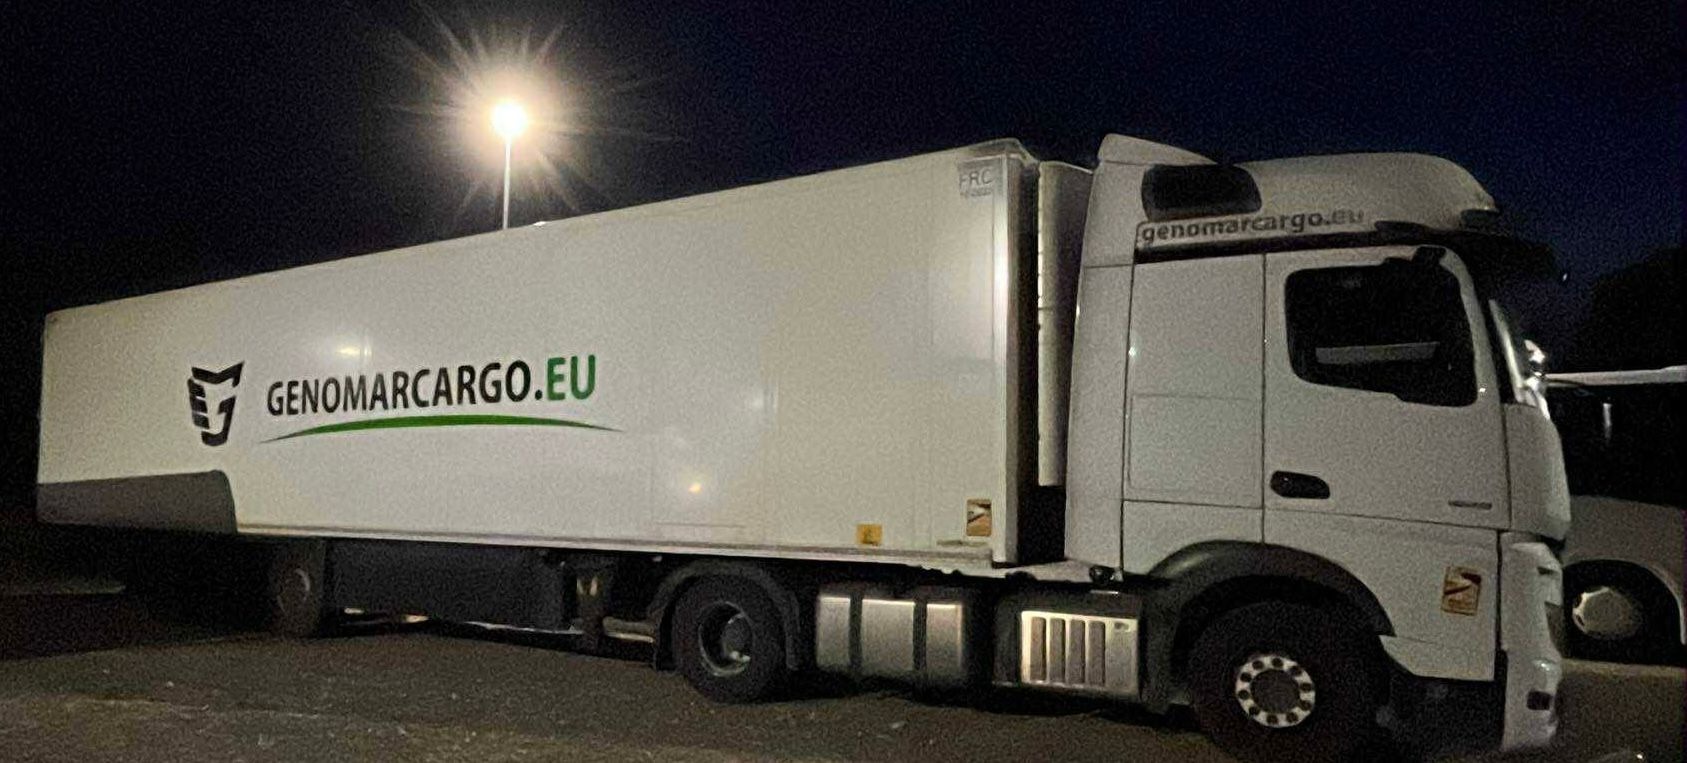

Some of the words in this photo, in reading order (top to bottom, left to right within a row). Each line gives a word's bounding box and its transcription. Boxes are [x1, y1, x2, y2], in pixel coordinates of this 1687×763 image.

[959, 167, 993, 187] FRC
[1141, 209, 1365, 243] genomarcargo.eu
[267, 354, 597, 416] GENOMARCARGO.EU
